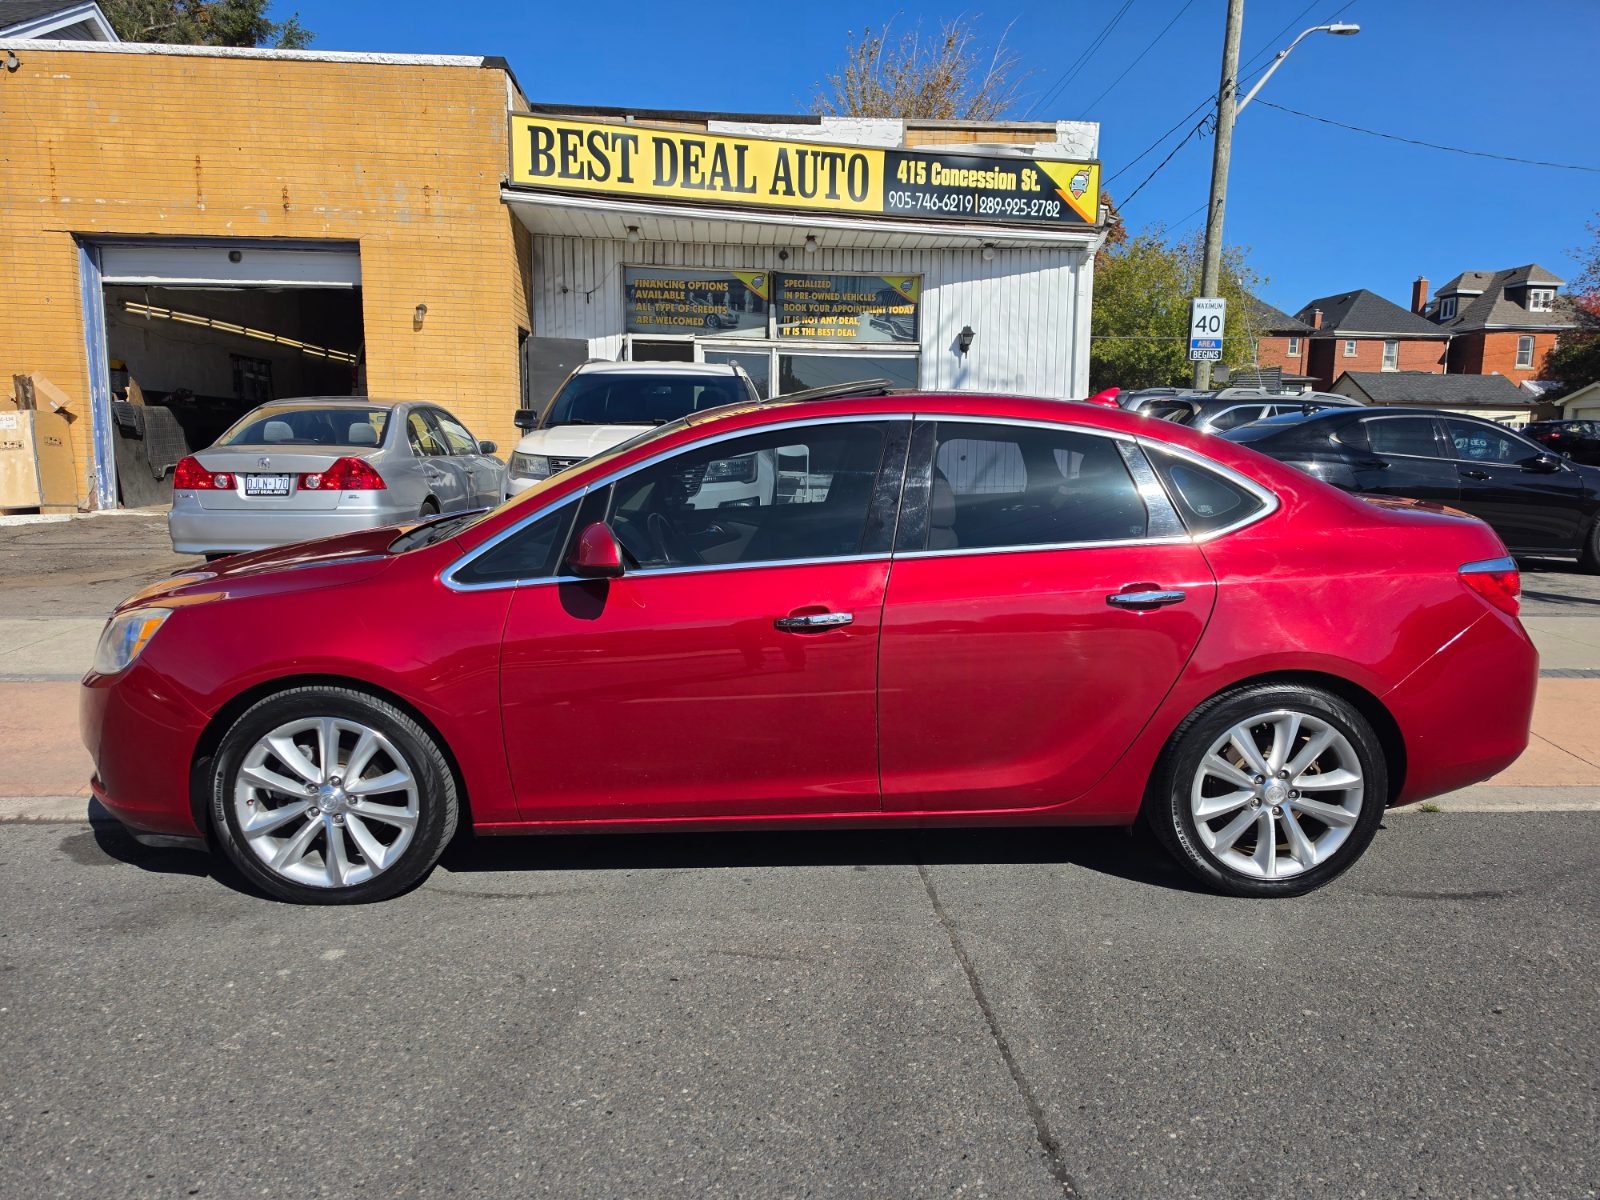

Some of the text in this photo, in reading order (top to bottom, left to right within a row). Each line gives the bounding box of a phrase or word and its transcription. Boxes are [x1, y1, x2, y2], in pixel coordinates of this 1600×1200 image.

[528, 125, 870, 202] BEST DEAL AUTO
[897, 159, 1041, 192] 415 Concession St.
[888, 190, 1060, 218] 905-746-6219 289-925-2782
[634, 279, 729, 291] FINANCING OPTIONS
[784, 279, 831, 288] SPECIALIZED
[635, 290, 686, 300] AVAILABLE
[784, 291, 877, 302] IN PRE-OWNED VEHICLES
[635, 302, 728, 314] ALL TYPE OF CREDITS
[784, 303, 915, 315] BOOK YOUR APPOINTMENT TODAY
[1196, 302, 1223, 310] MAXIMUM
[635, 315, 704, 326] ARE WELCOMED
[783, 315, 790, 324] IT
[792, 315, 800, 324] IS
[801, 316, 819, 325] NOT
[820, 316, 838, 325] ANY
[1195, 315, 1221, 333] 40
[783, 328, 857, 337] IT IS THE BEST DEAL
[1197, 340, 1216, 348] AREA
[1193, 350, 1219, 359] BEGINS
